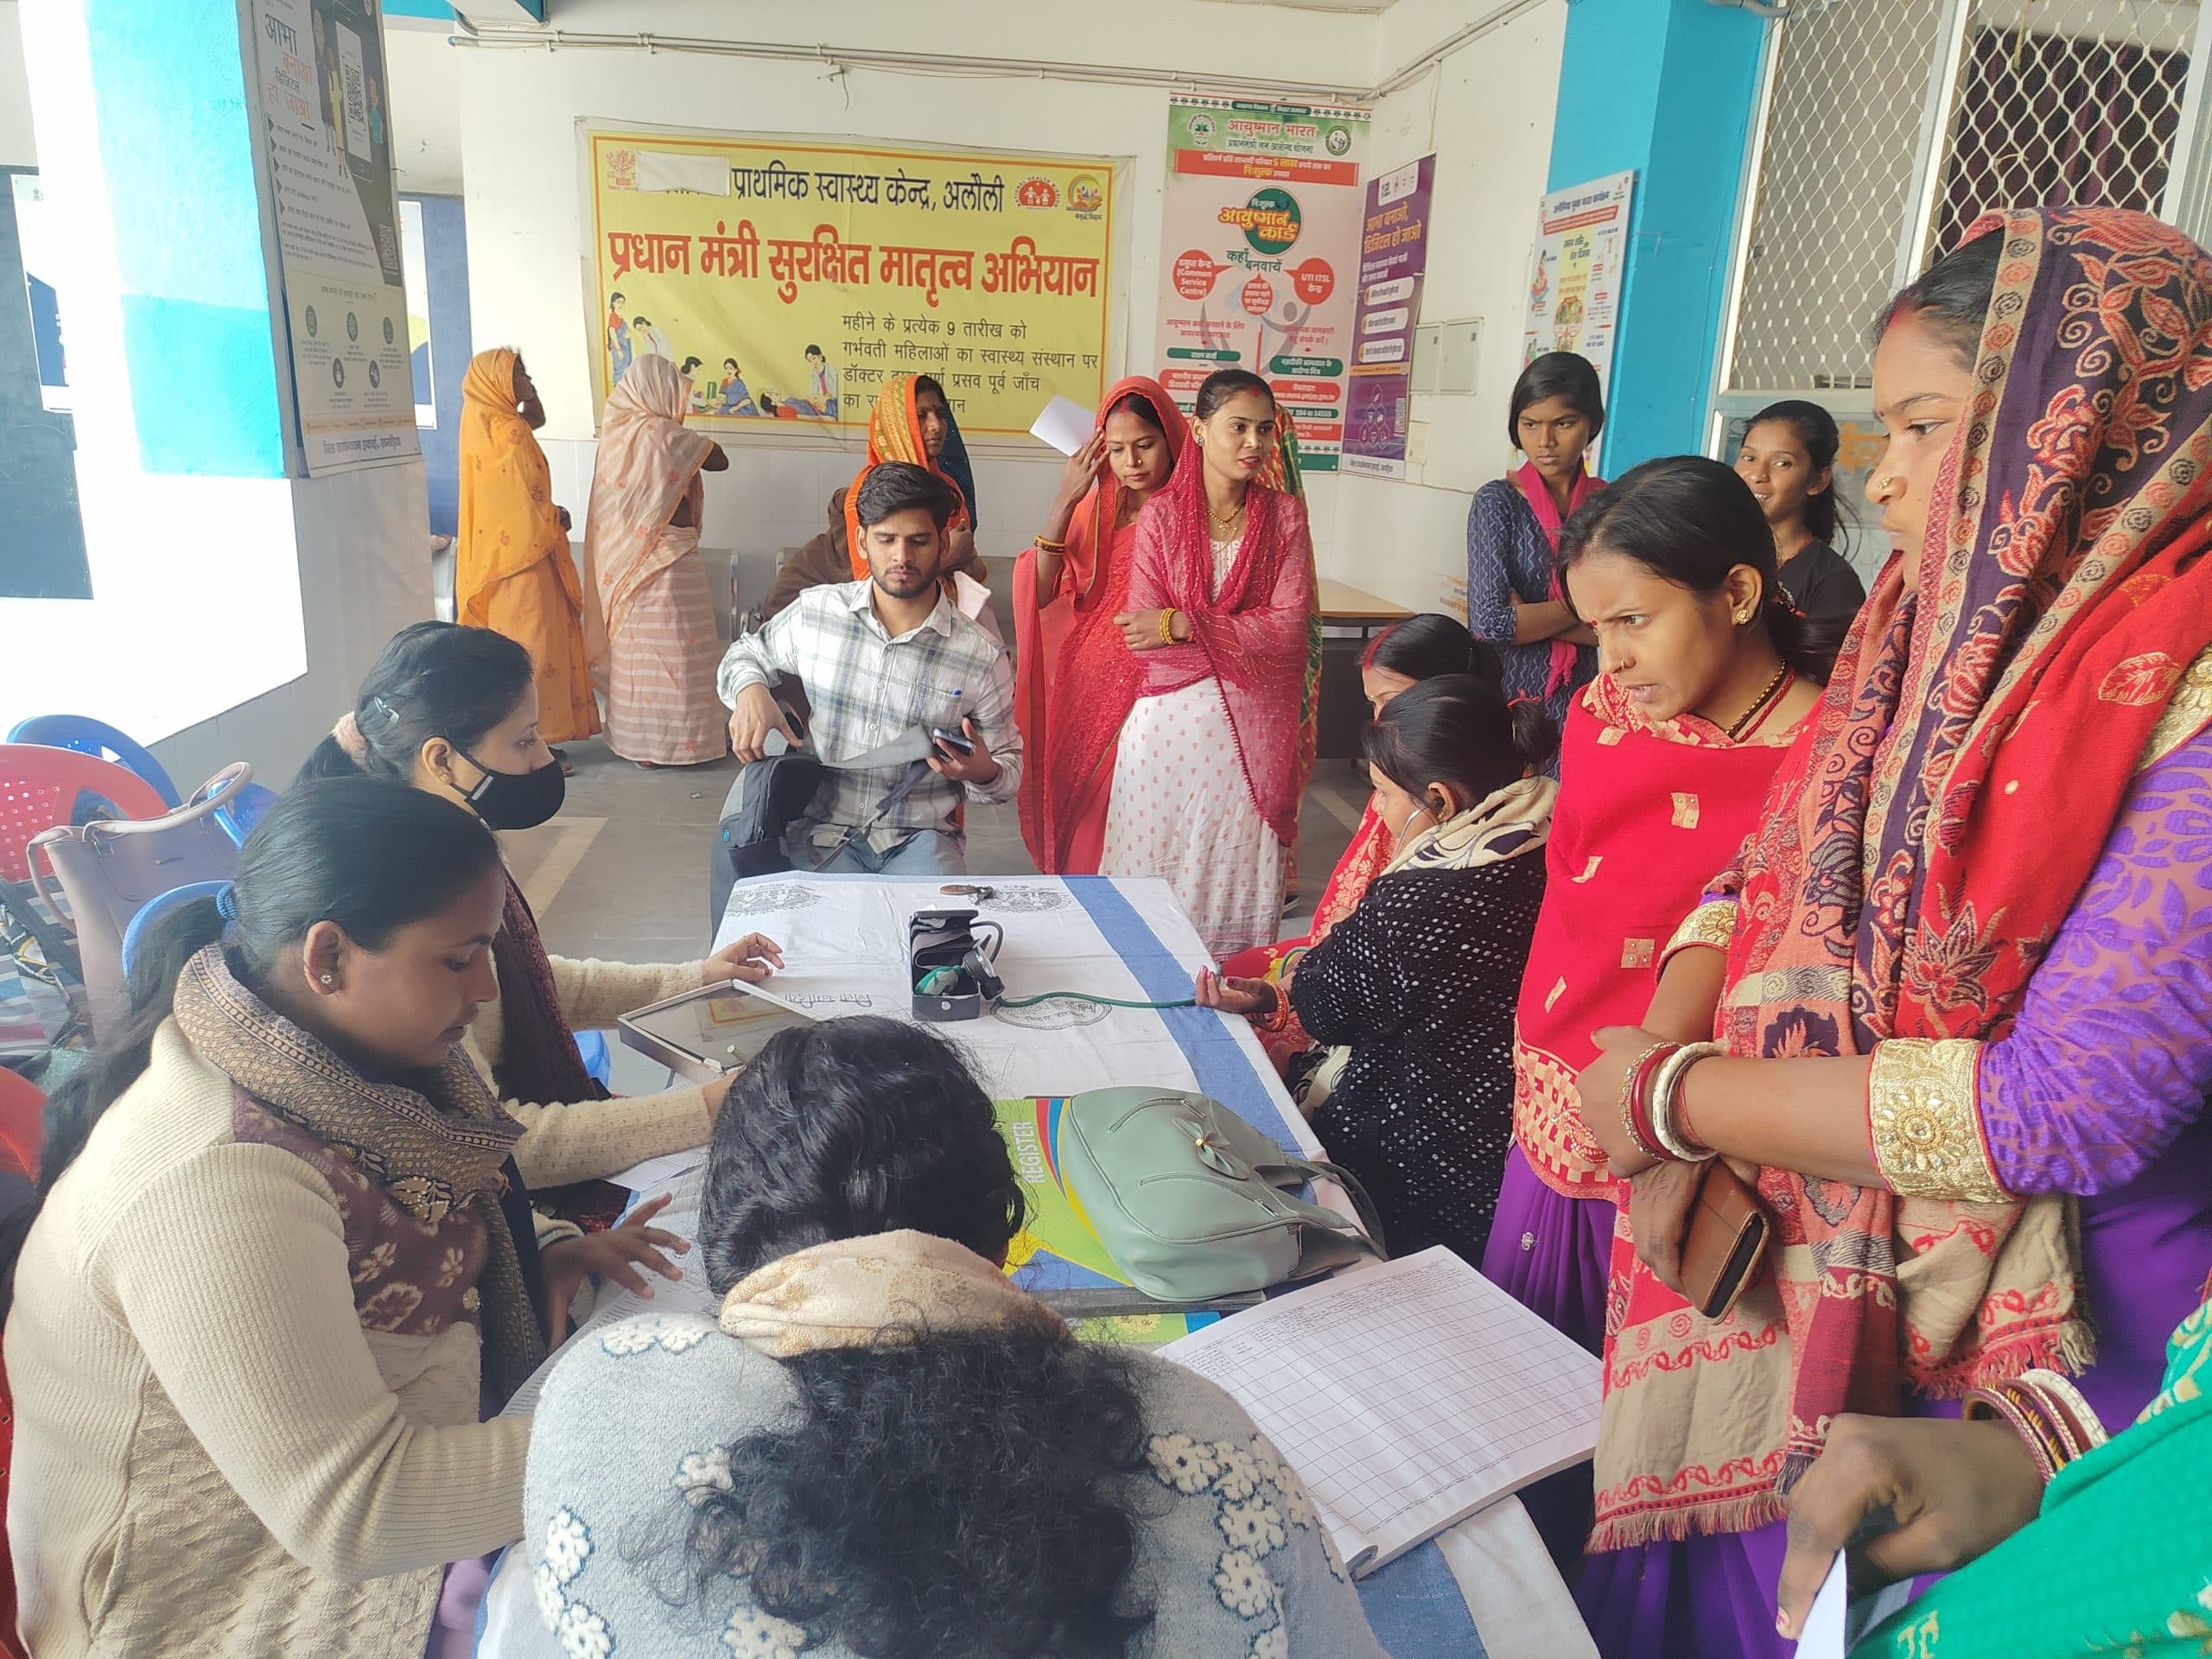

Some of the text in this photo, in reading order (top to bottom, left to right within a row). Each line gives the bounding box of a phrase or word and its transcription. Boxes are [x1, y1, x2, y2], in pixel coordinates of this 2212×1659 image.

[265, 13, 297, 56] आभा
[1228, 120, 1280, 137] आयुष्मान
[1286, 125, 1317, 137] भारत
[731, 159, 1005, 213] प्राथमिक स्वास्थ्य केन्द्र, अलौली
[1218, 207, 1291, 230] आयुष्मान
[1258, 222, 1300, 242] कार्ड
[607, 219, 1100, 308] प्रधान मंत्री सुरक्षित मातृत्व अभियान
[1227, 247, 1249, 263] कहाँ
[1245, 257, 1283, 273] बनवायें
[842, 311, 1027, 340] महीने के प्रत्येक 9 तारीख को
[842, 337, 1098, 370] गर्भवती महिलाओं का स्वास्थ्य संस्थान पर
[842, 363, 884, 384] डॉक्टर
[952, 372, 982, 389] प्रसव
[988, 370, 1007, 395] पूर्व
[1013, 372, 1040, 391] जाँच
[842, 391, 860, 409] का
[1013, 1122, 1045, 1183] REGISTER
